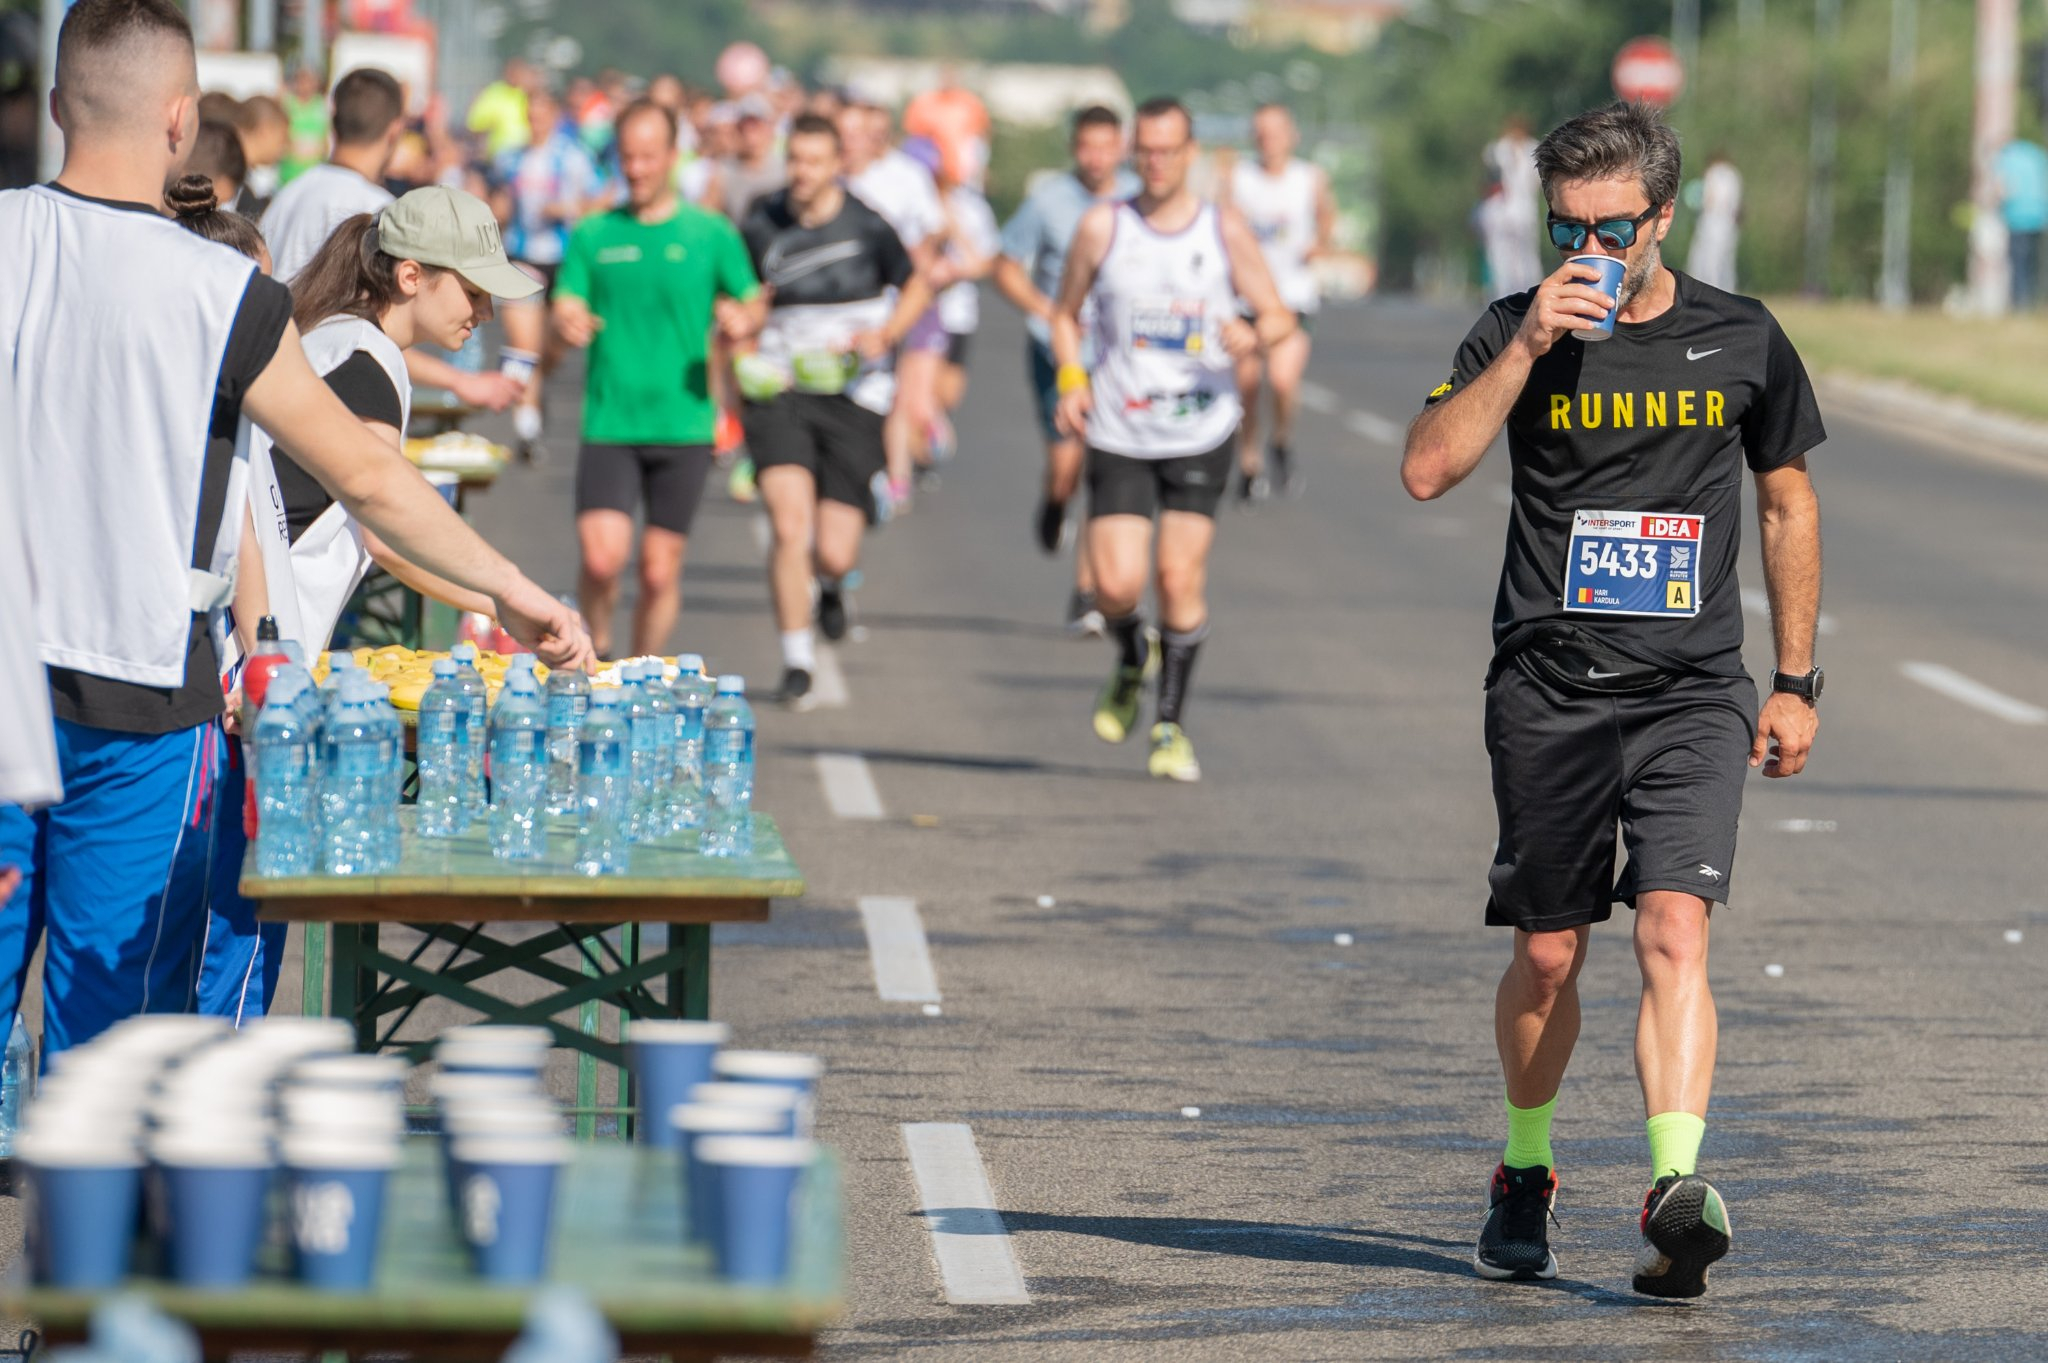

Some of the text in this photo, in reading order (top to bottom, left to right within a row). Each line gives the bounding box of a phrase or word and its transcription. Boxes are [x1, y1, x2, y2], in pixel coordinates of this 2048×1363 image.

[1550, 390, 1725, 430] RUNNER
[1587, 519, 1635, 528] INTERSPORT
[1579, 541, 1658, 579] 5433
[1594, 588, 1608, 597] HARI
[1673, 586, 1684, 604] A
